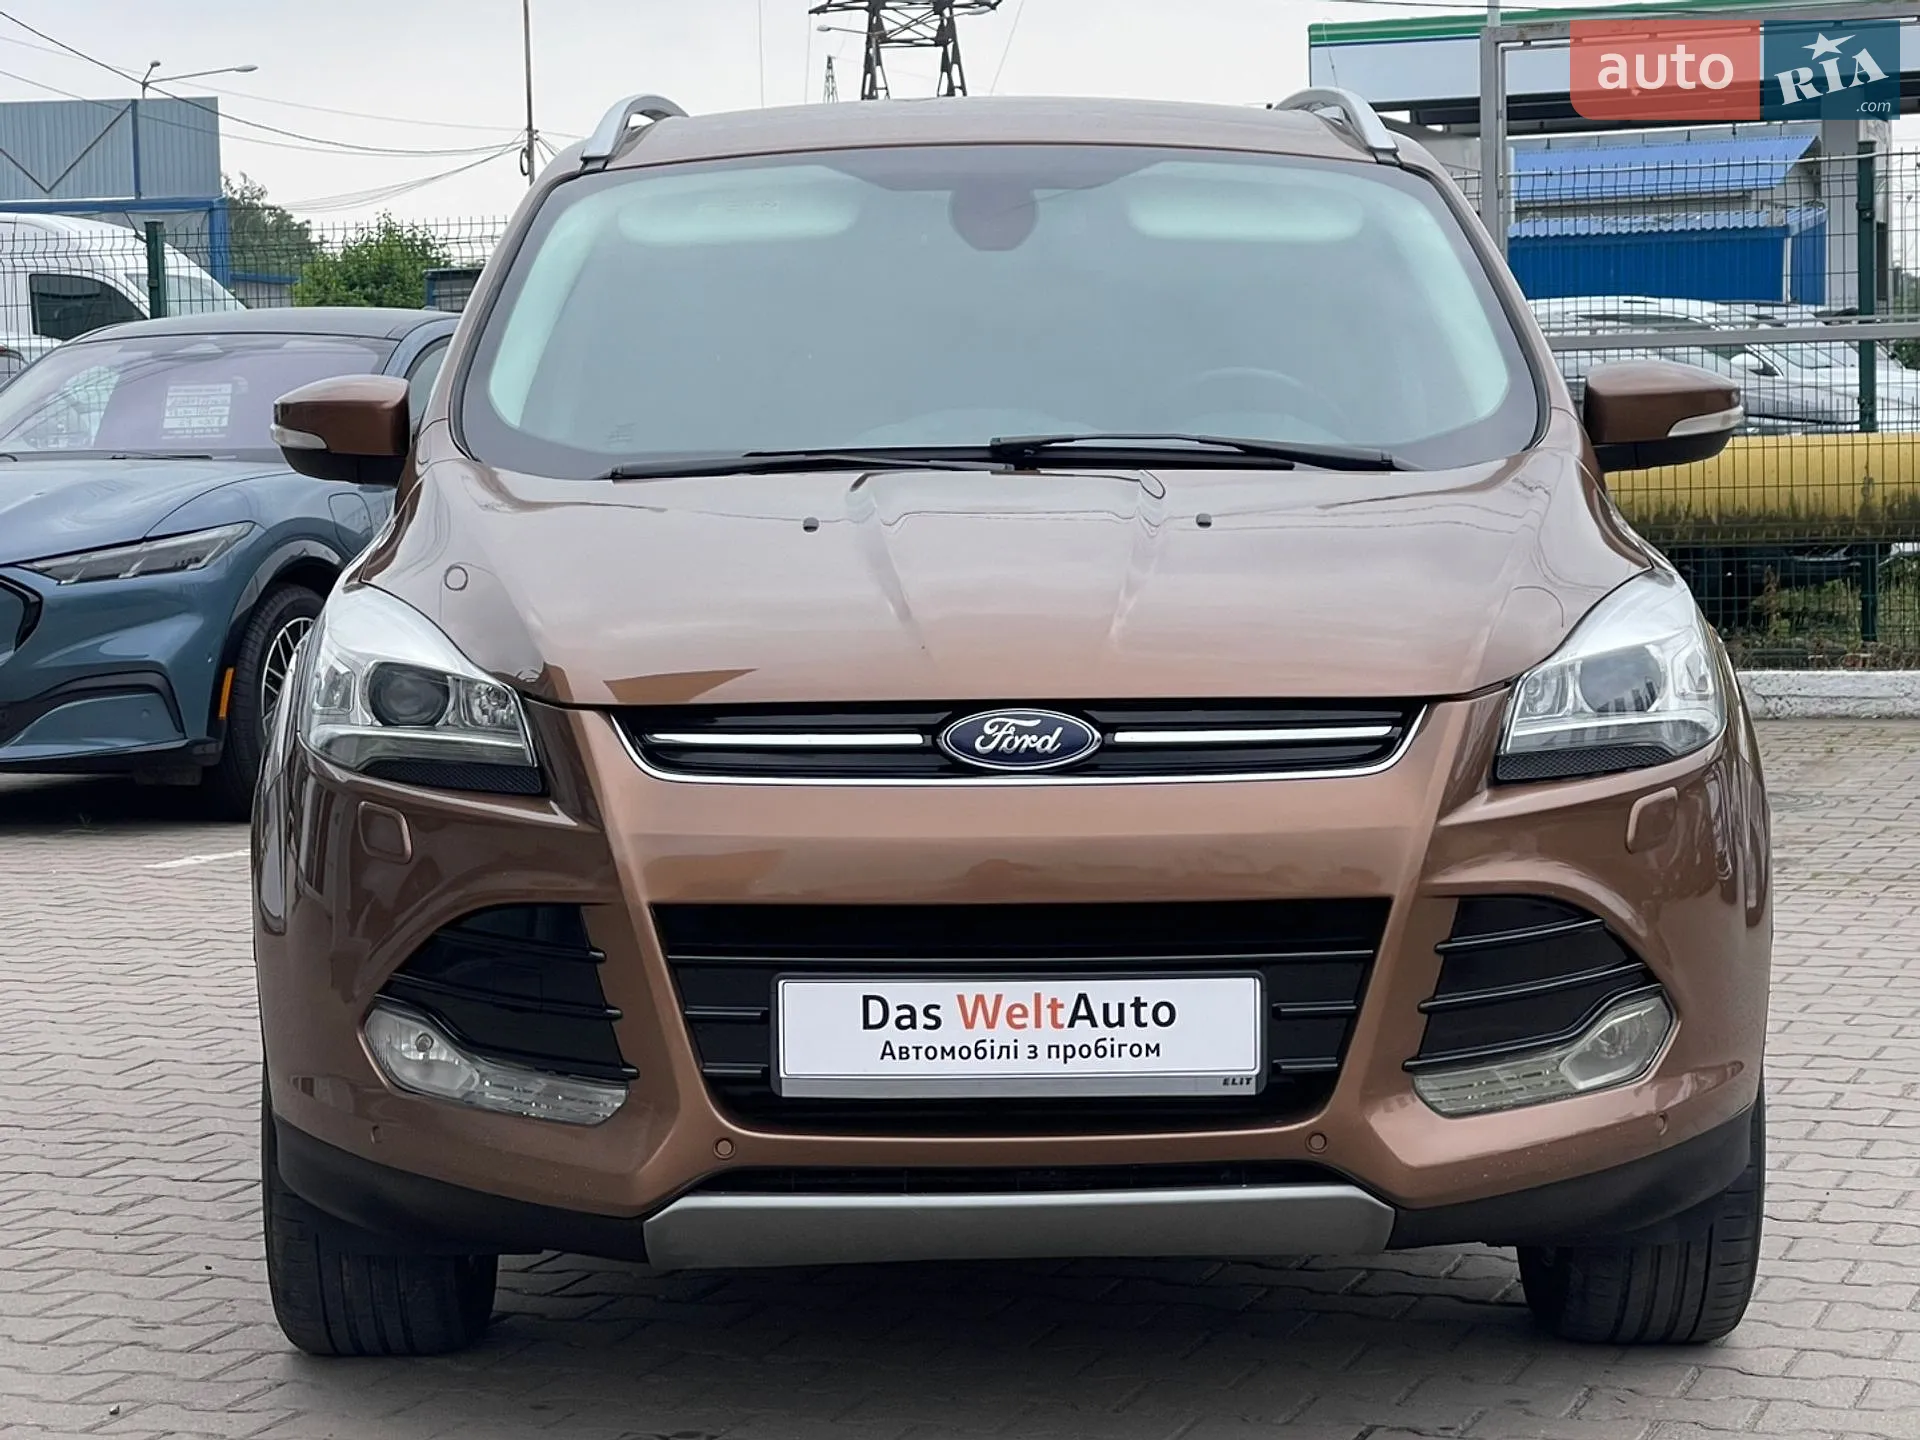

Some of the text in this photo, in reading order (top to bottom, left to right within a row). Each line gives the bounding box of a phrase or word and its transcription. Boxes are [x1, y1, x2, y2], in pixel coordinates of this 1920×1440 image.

[974, 717, 1063, 754] Ford
[861, 992, 1177, 1031] Das WeltAuto
[880, 1037, 1161, 1063] Автомобілі з пробігом
[1222, 1077, 1253, 1086] ELIT
